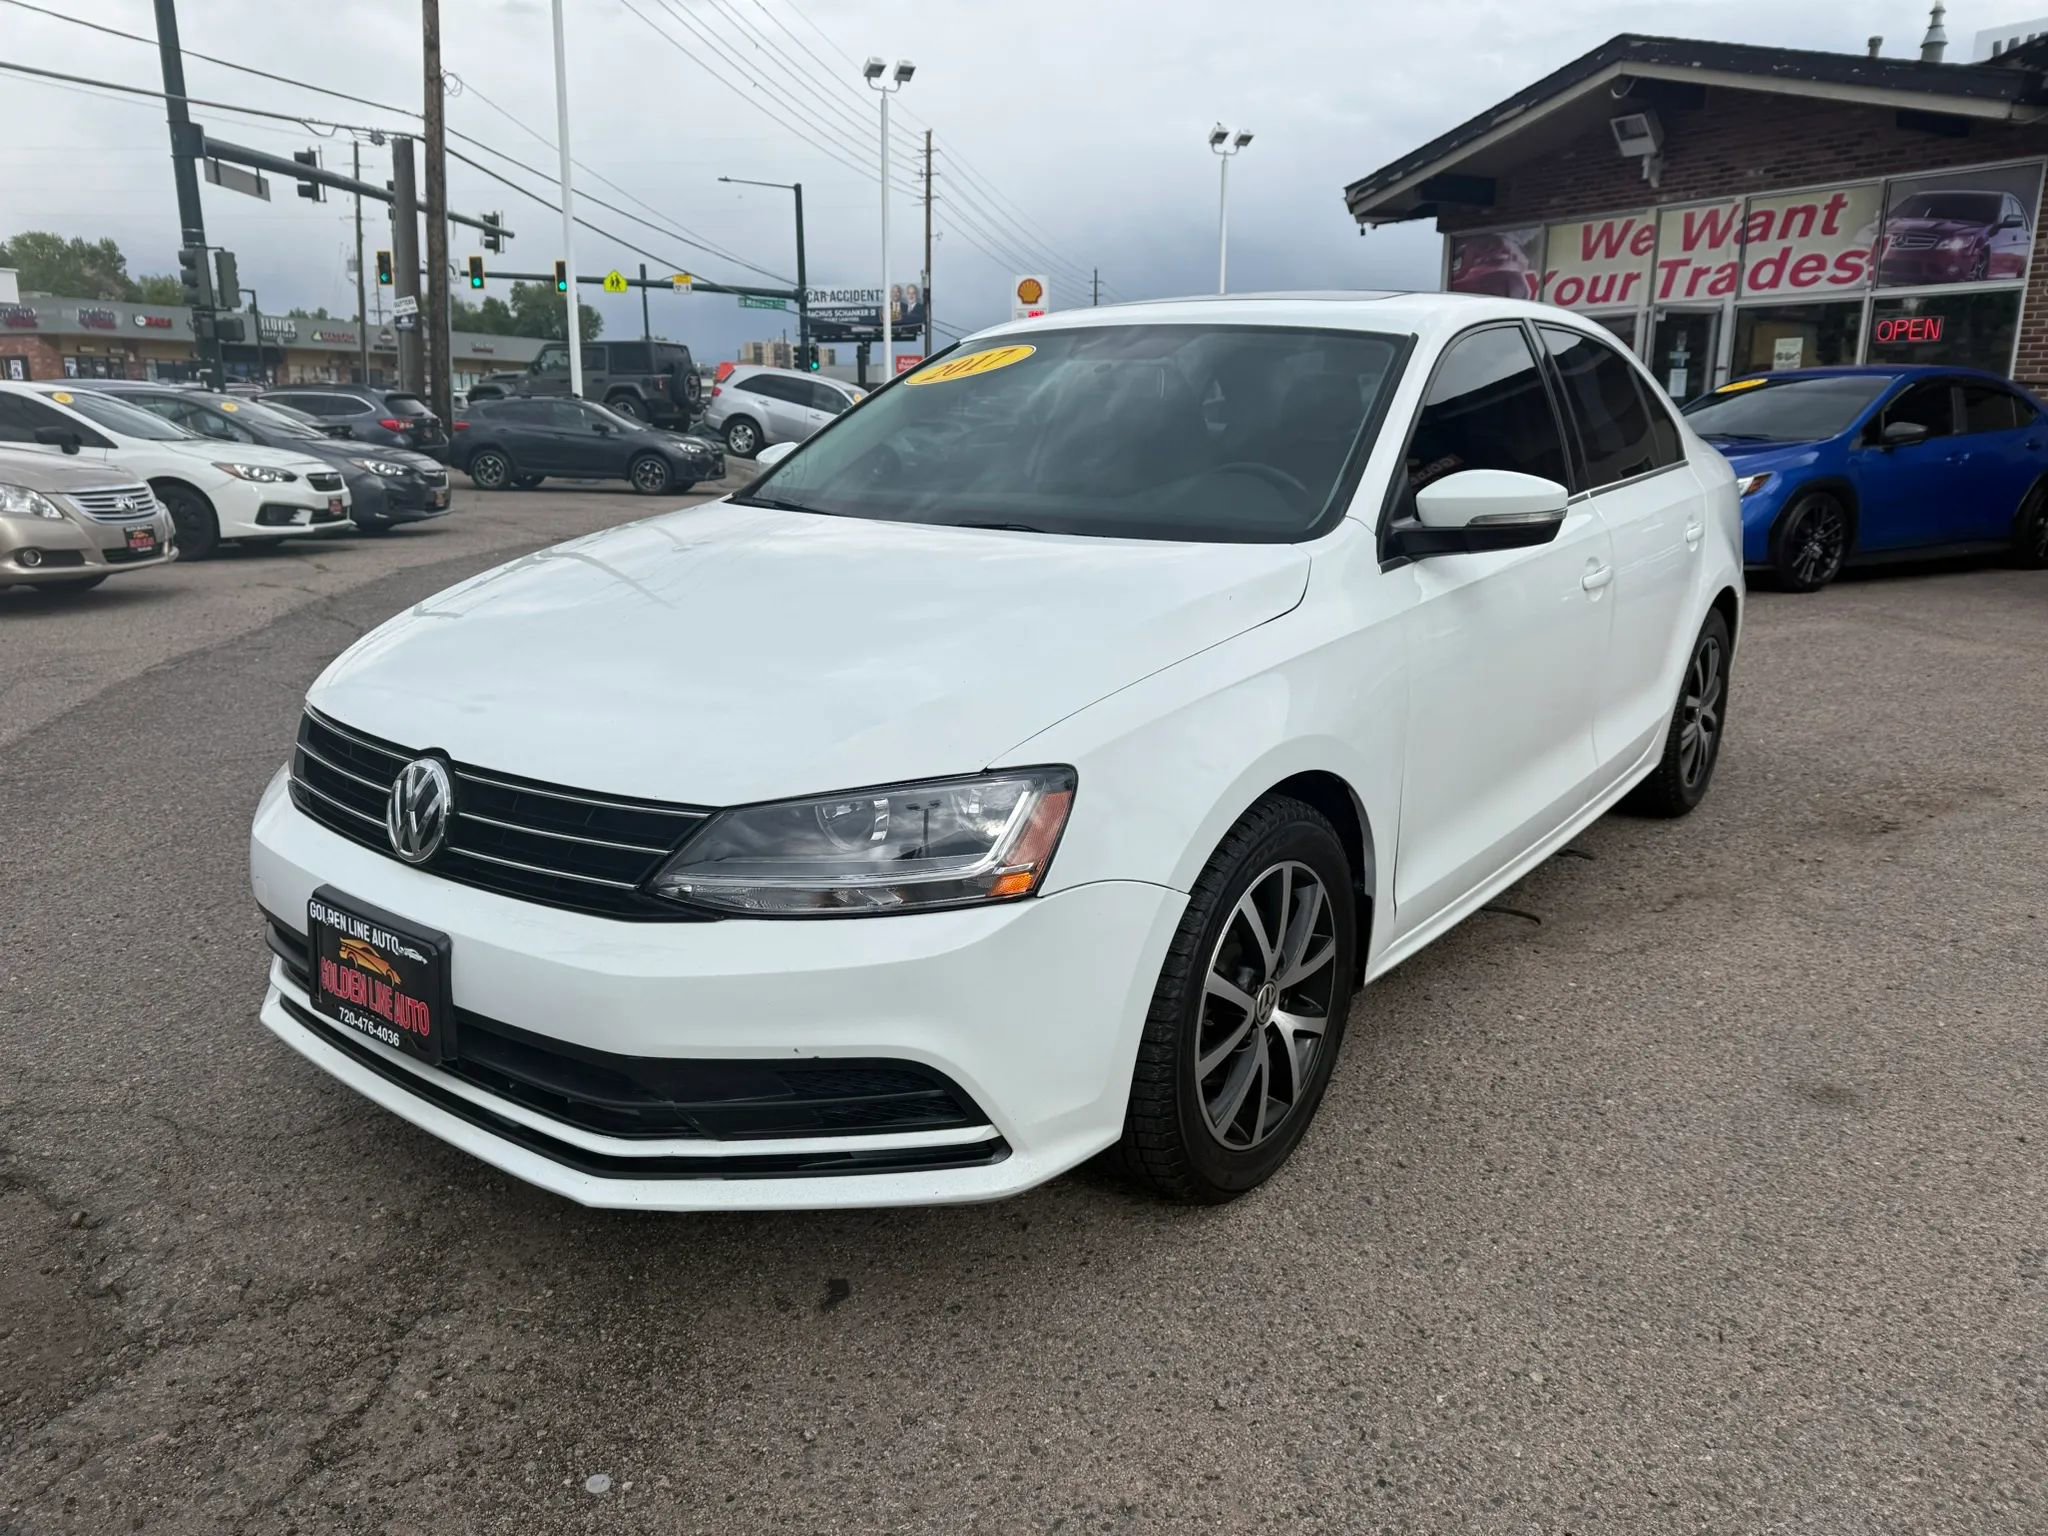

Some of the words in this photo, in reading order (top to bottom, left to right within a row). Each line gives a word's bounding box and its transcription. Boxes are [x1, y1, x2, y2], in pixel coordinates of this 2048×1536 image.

[1581, 218, 1657, 262] We
[1681, 192, 1849, 252] Want
[806, 290, 827, 302] CAR
[1524, 269, 1642, 306] Your
[1877, 318, 1941, 341] OPEN
[920, 348, 1019, 382] 2017
[309, 901, 347, 933] GOLDEN
[347, 917, 371, 943] LINE
[371, 927, 400, 956] AUTO
[320, 956, 368, 1008] GOLDEN
[367, 976, 394, 1021] LINE
[393, 991, 430, 1037] AUTO
[338, 1006, 400, 1047] 720-476-4036
